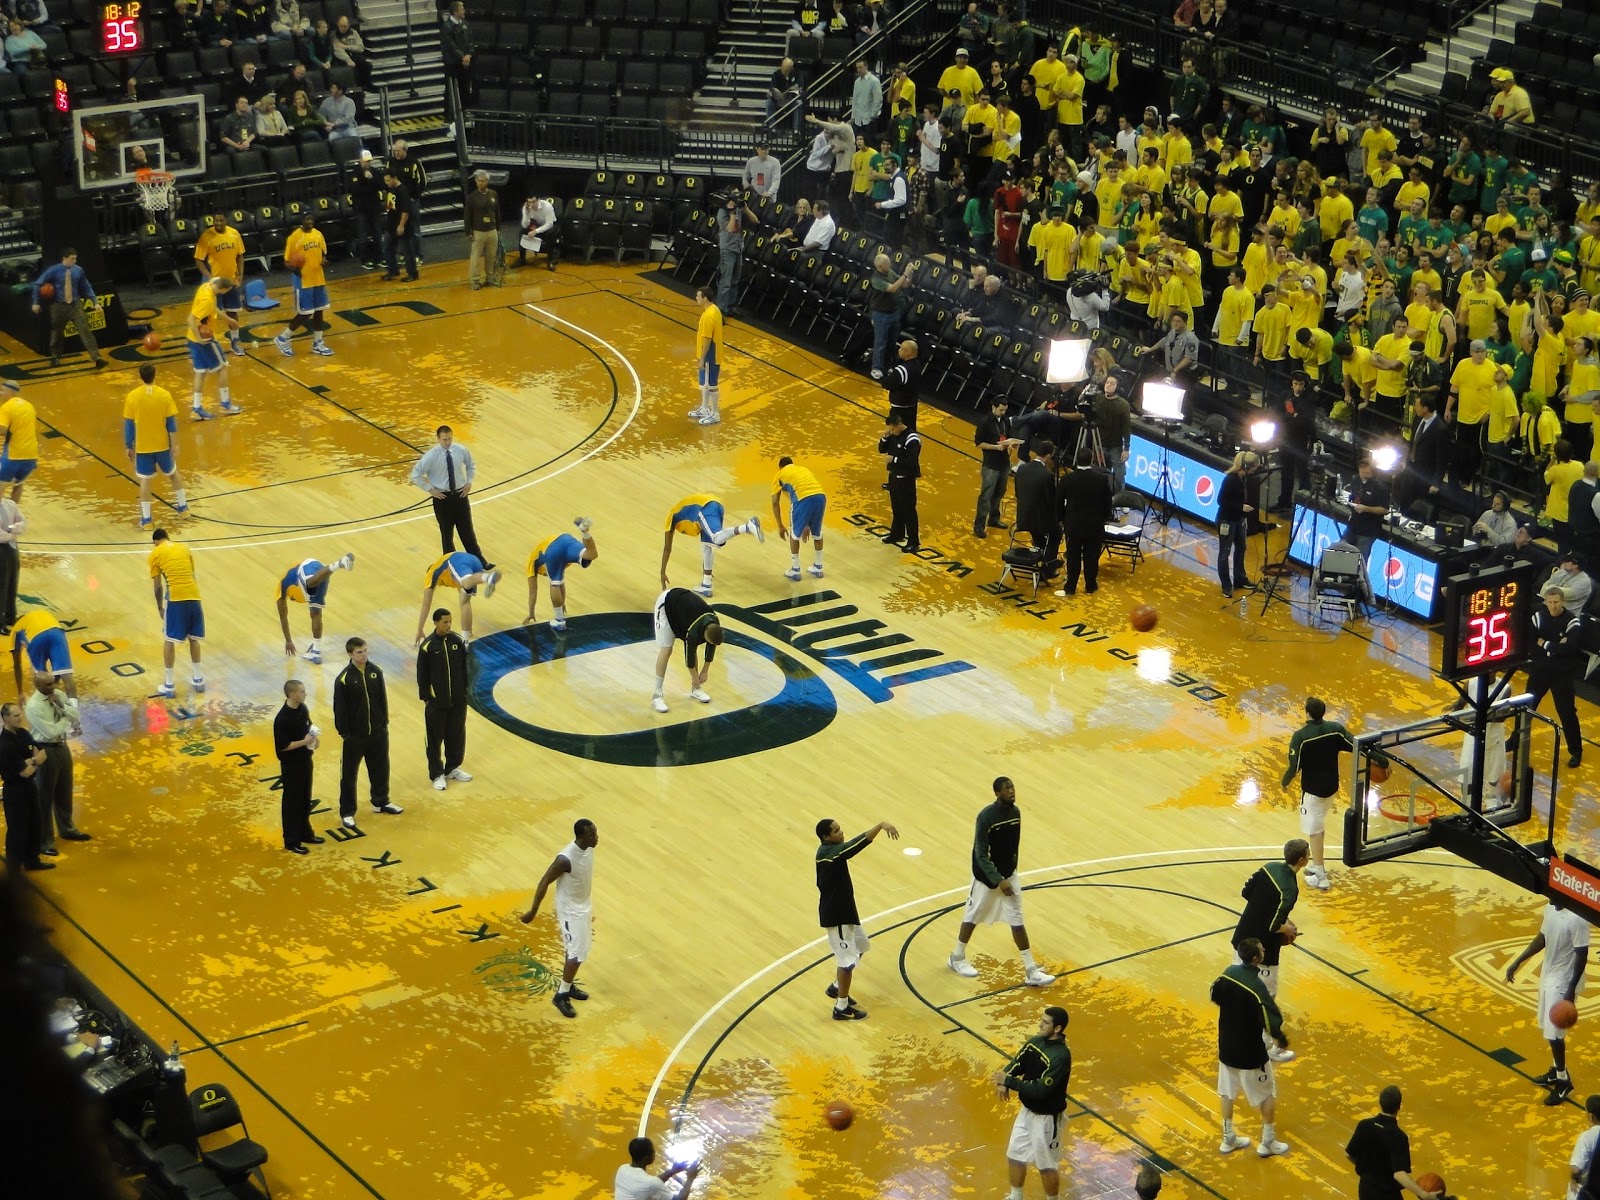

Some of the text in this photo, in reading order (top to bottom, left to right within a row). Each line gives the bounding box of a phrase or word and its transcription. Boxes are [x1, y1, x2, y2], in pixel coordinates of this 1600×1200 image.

[105, 2, 141, 20] 18:12
[106, 20, 138, 50] 35
[215, 243, 236, 252] UCLA
[1134, 455, 1186, 492] pepsi
[1470, 582, 1517, 614] 18:12
[1060, 622, 1109, 643] IN
[1467, 612, 1508, 662] 35
